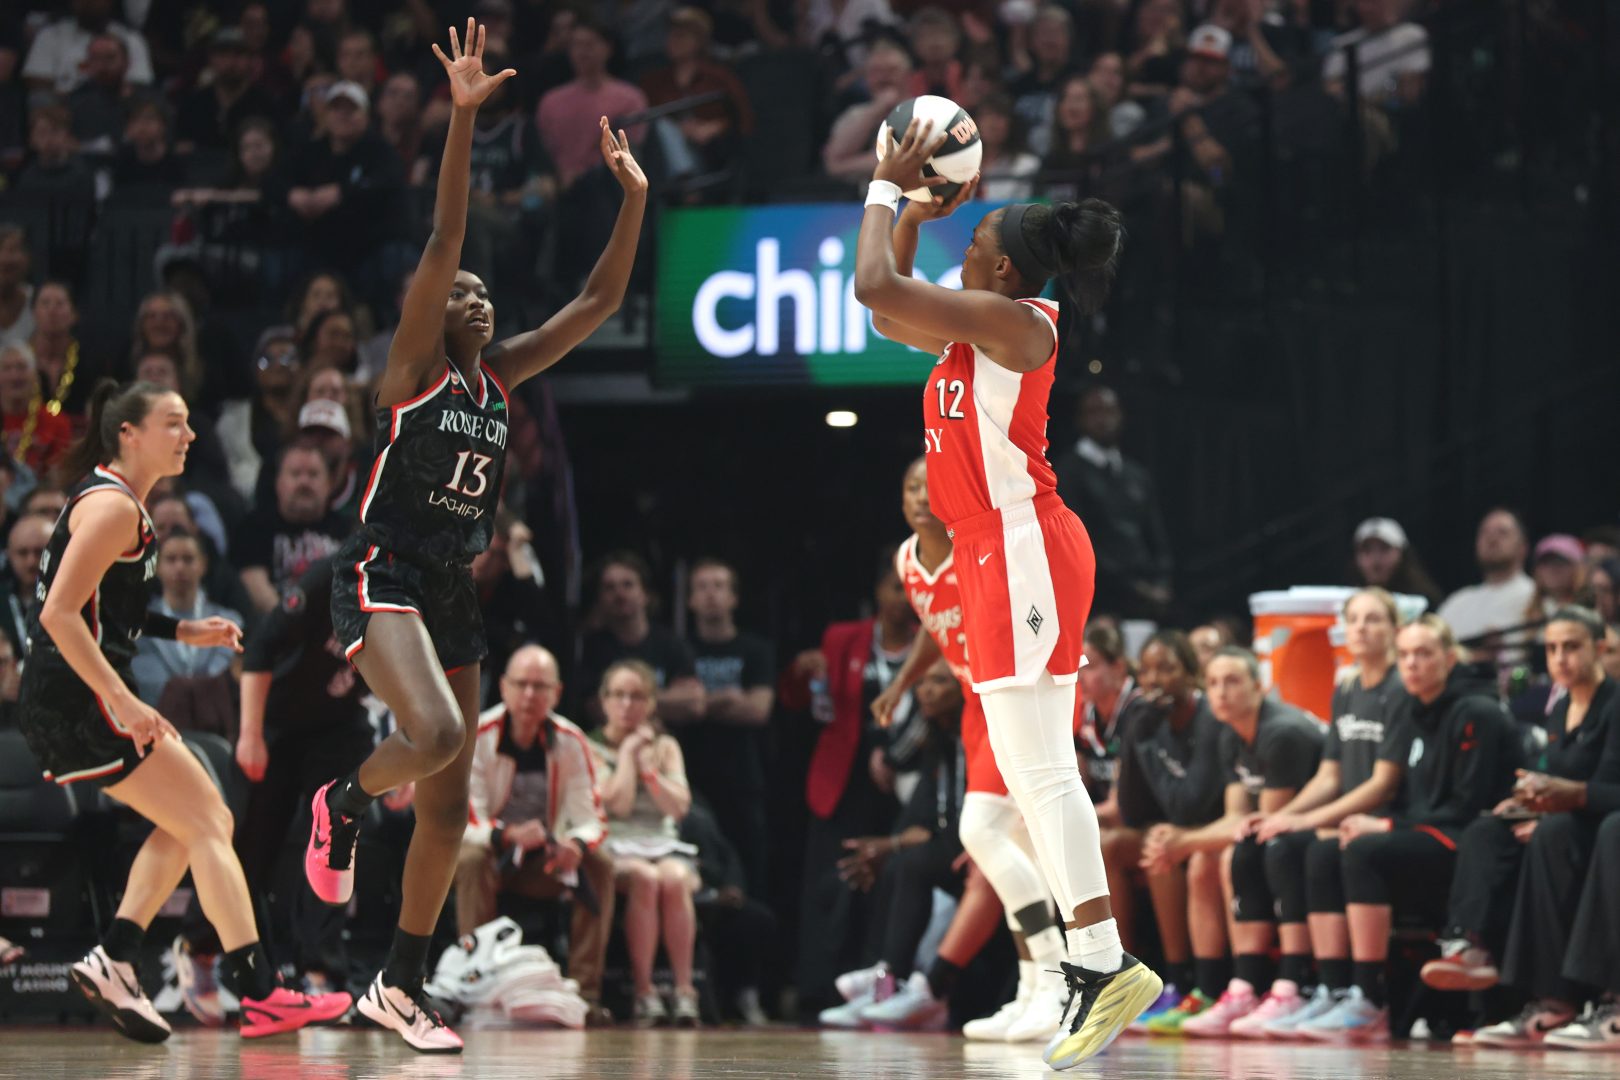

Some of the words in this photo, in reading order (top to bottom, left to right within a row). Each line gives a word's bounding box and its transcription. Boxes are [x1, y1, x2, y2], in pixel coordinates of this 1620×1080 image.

[935, 377, 966, 420] 12
[437, 409, 484, 439] ROSE
[445, 450, 493, 498] 13
